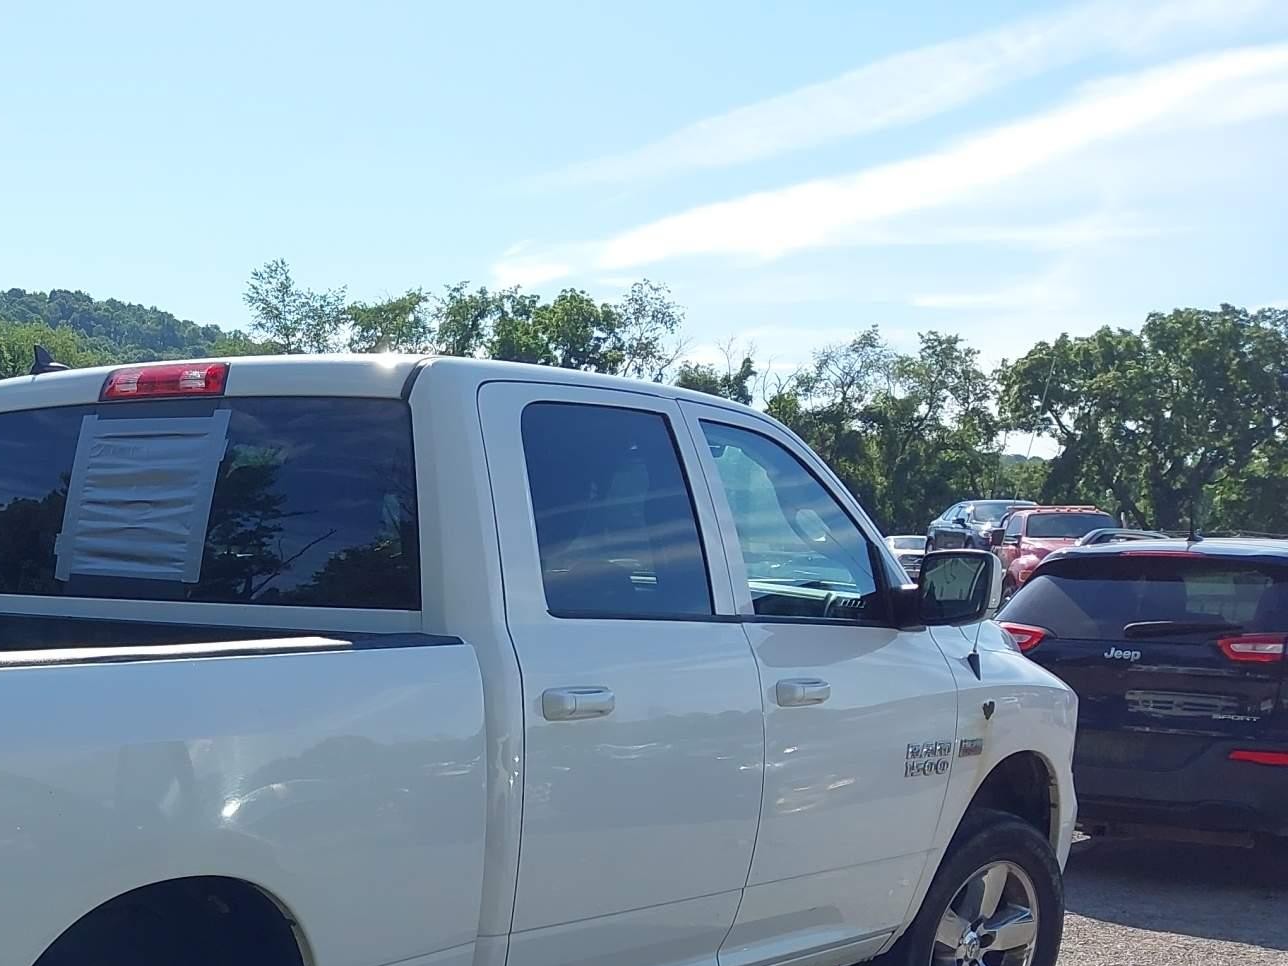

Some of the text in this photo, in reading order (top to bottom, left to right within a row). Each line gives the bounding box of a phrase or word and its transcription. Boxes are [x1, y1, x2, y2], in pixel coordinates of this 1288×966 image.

[1104, 646, 1141, 662] Jeep
[1211, 713, 1261, 722] SPORT
[906, 741, 951, 759] RAM
[904, 758, 949, 777] 1500
